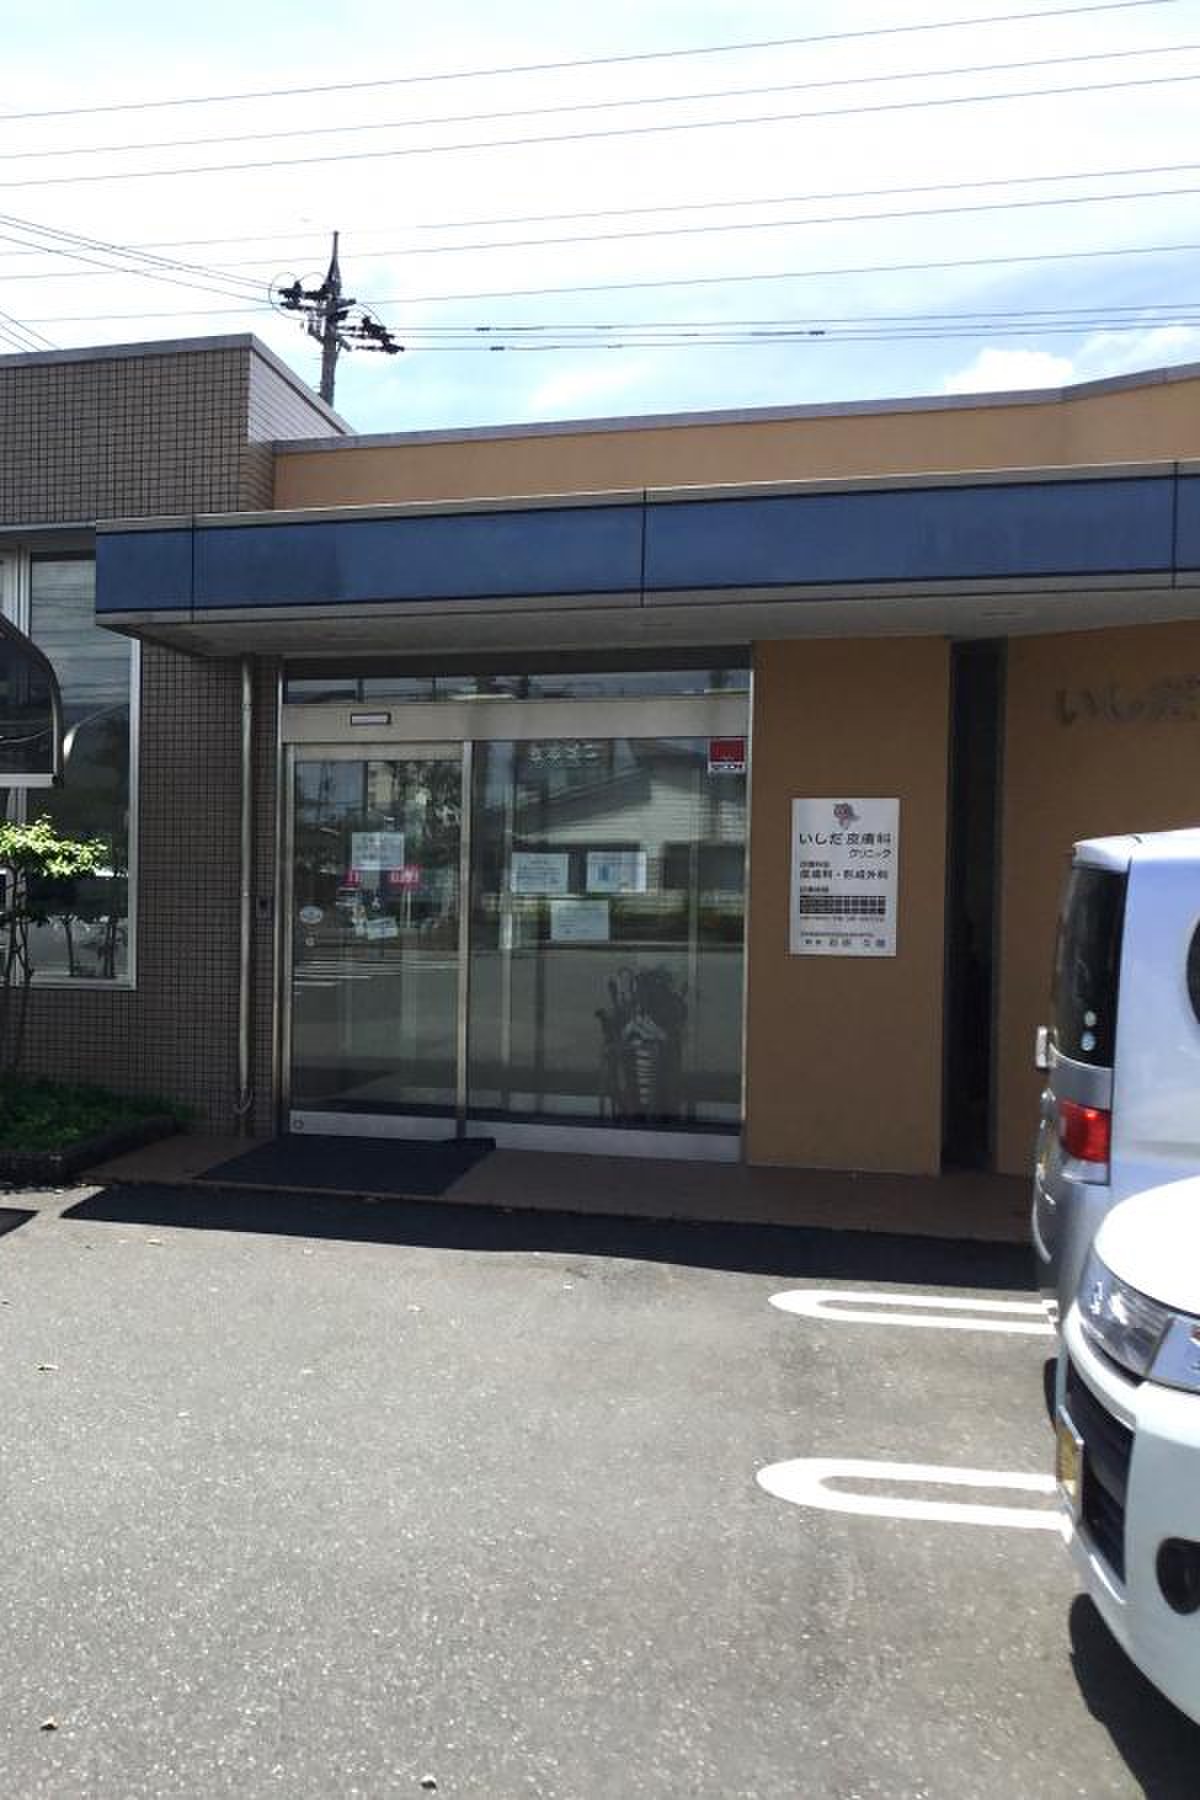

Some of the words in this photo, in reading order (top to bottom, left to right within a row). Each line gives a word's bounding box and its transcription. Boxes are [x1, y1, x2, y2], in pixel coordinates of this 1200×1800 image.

[799, 832, 892, 845] いしだ皮膚科
